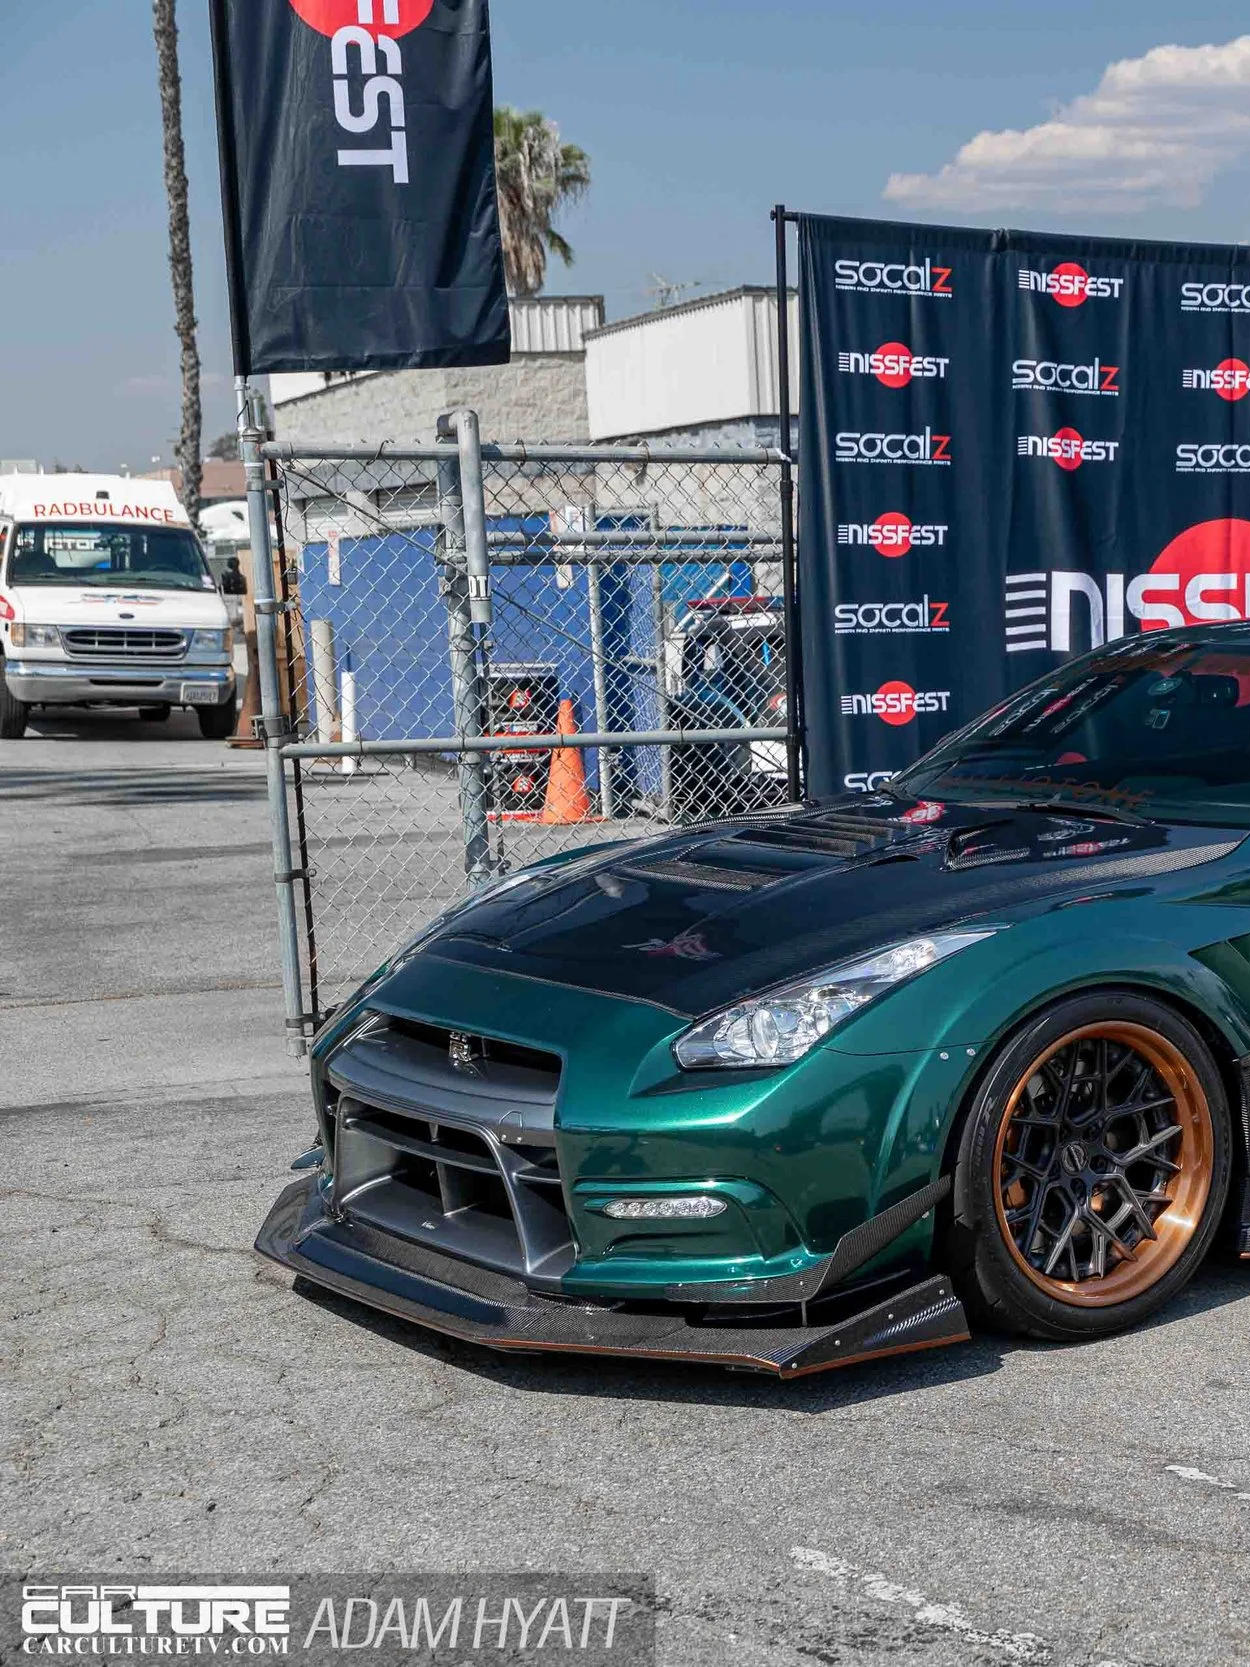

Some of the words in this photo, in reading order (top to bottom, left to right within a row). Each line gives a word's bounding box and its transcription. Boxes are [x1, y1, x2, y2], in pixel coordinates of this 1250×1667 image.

[1030, 269, 1123, 298] NISSFEST
[849, 352, 949, 378] NISSFEST
[1028, 436, 1119, 462] NISSFEST
[34, 502, 174, 522] RADBULANCE
[848, 524, 948, 546] NISSFEST
[852, 691, 950, 714] NISSFEST
